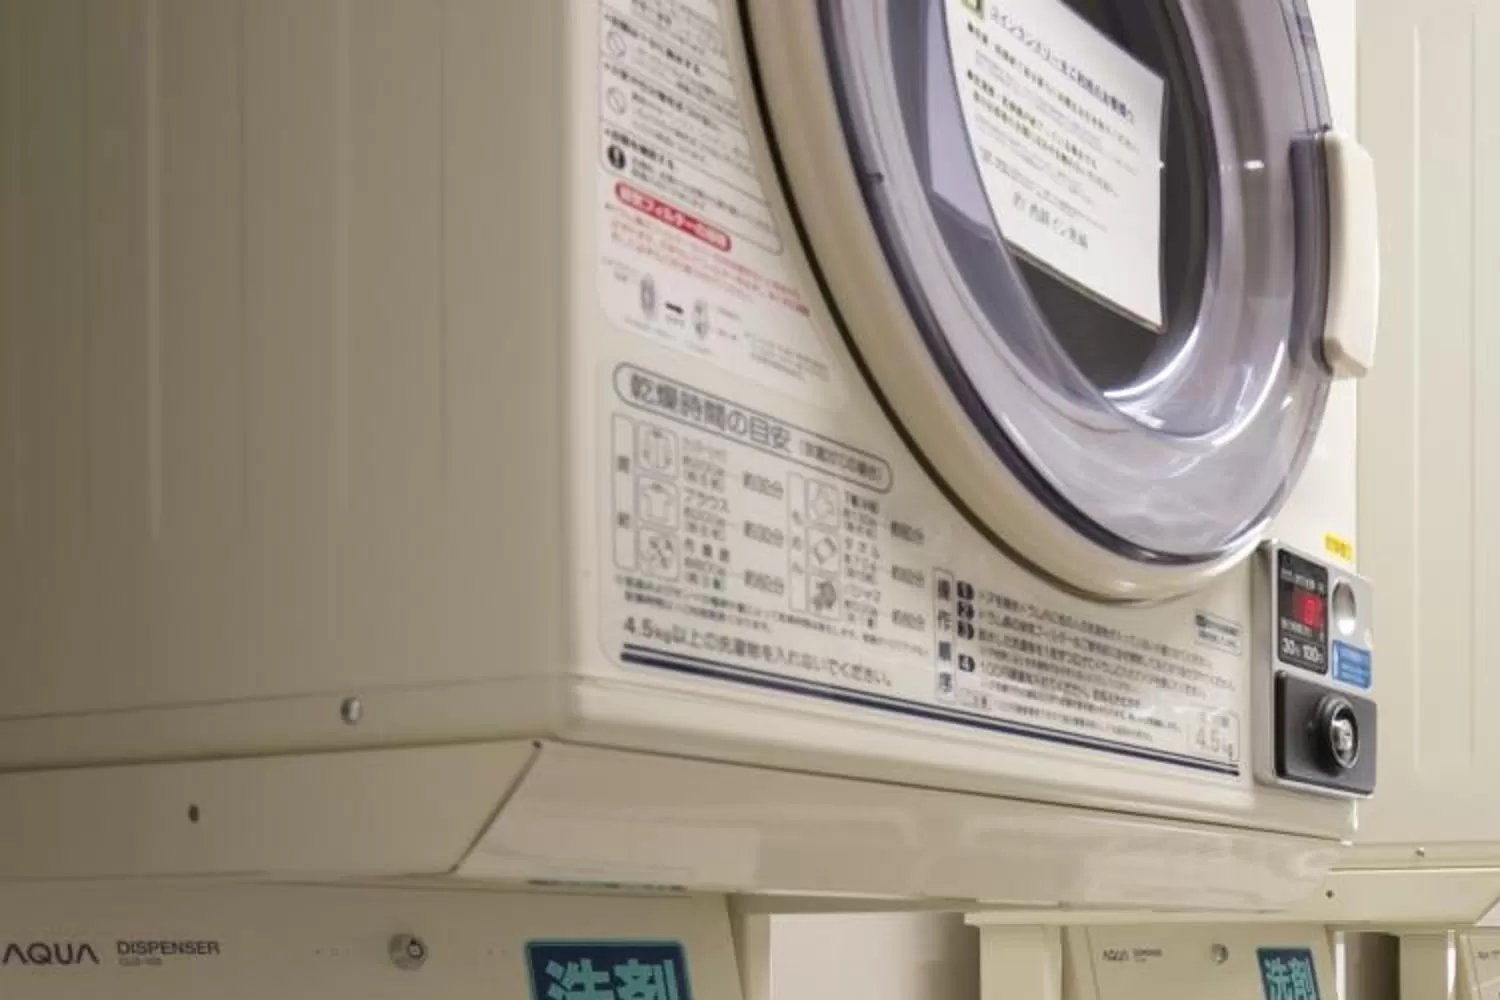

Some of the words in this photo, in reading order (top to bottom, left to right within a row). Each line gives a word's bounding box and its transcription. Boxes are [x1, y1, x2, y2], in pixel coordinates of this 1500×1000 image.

[629, 372, 791, 453] 乾燥時間の目安
[2, 942, 99, 965] AQUA
[116, 940, 221, 956] DISPENSER
